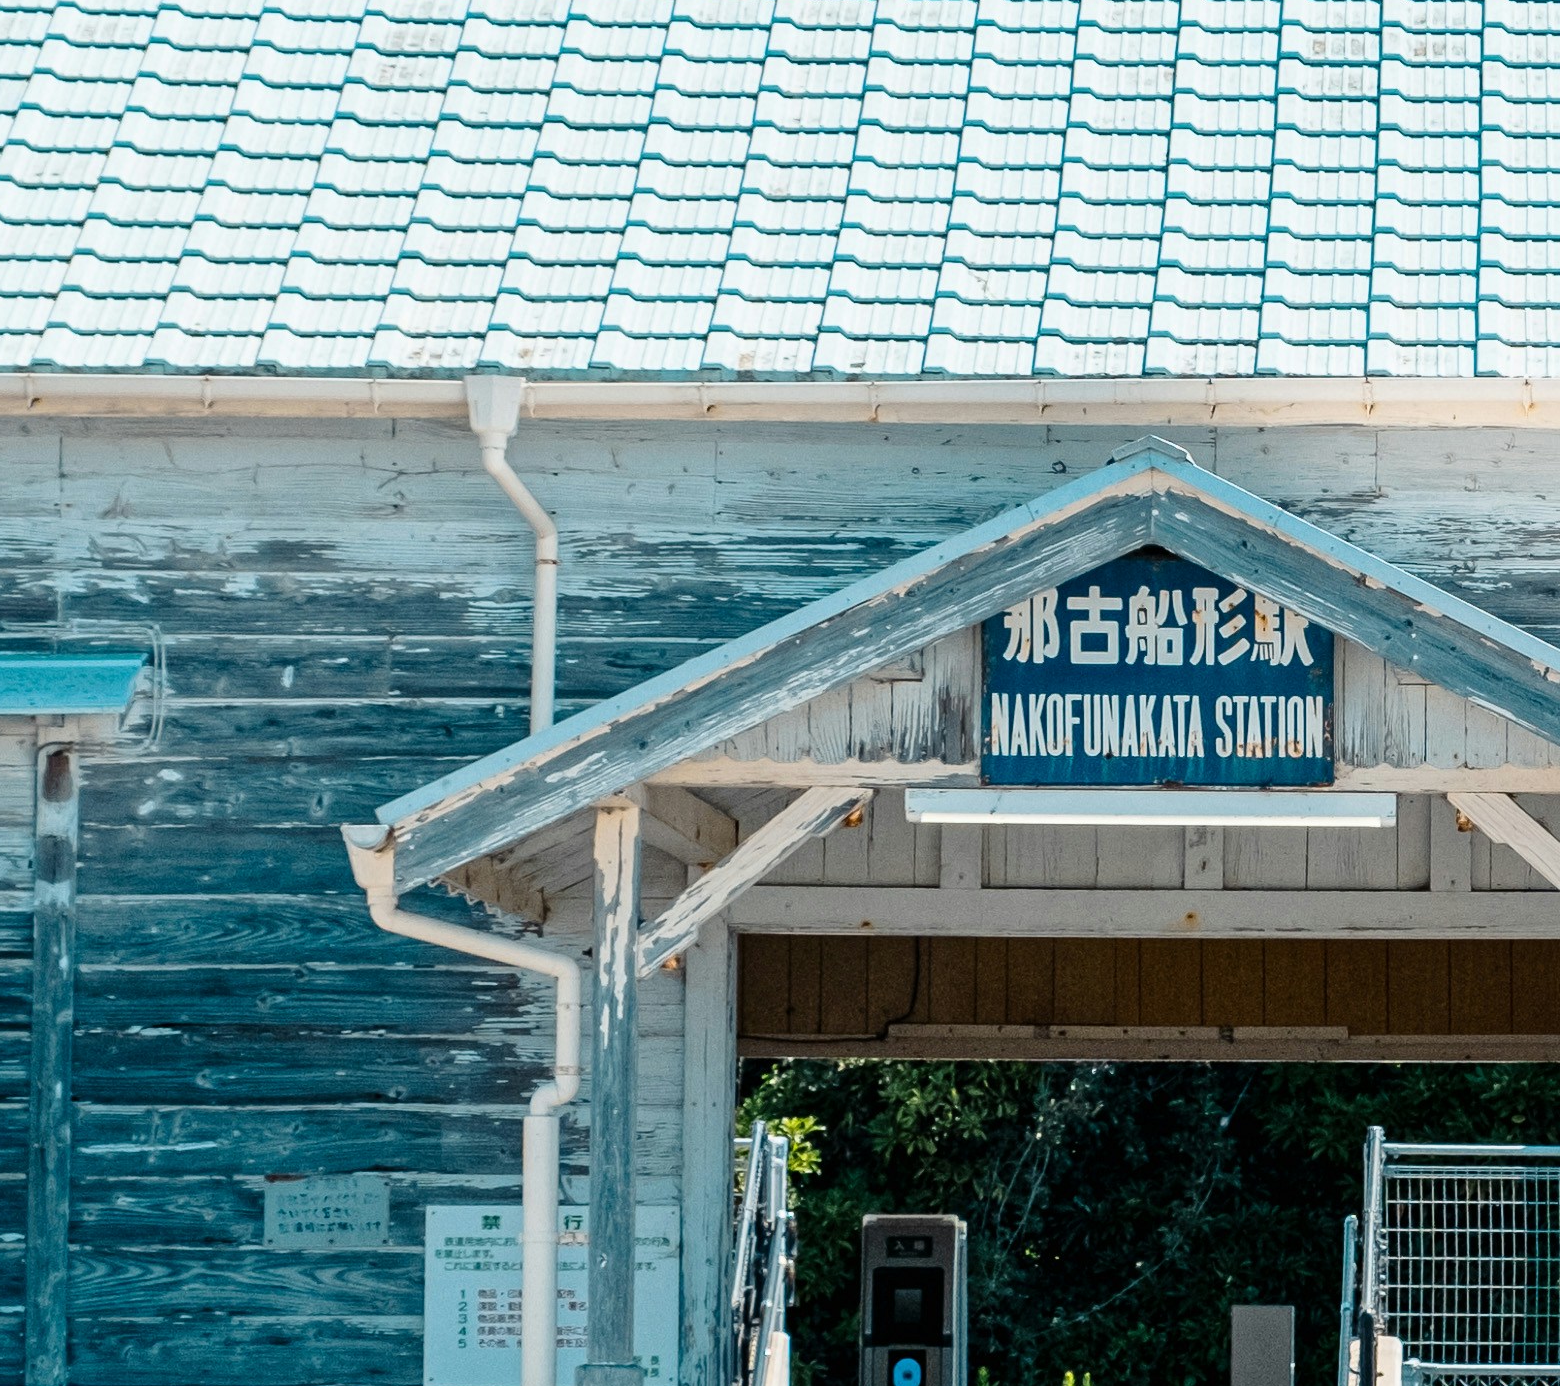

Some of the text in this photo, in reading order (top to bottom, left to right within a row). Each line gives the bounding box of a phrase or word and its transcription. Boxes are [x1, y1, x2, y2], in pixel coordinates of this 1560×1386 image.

[1002, 584, 1314, 667] 那古船形駅
[991, 692, 1324, 760] NAKOFUNAKATA STATION
[458, 1302, 467, 1312] 2
[458, 1314, 467, 1324] 3
[458, 1326, 467, 1336] 4
[458, 1339, 467, 1349] 5
